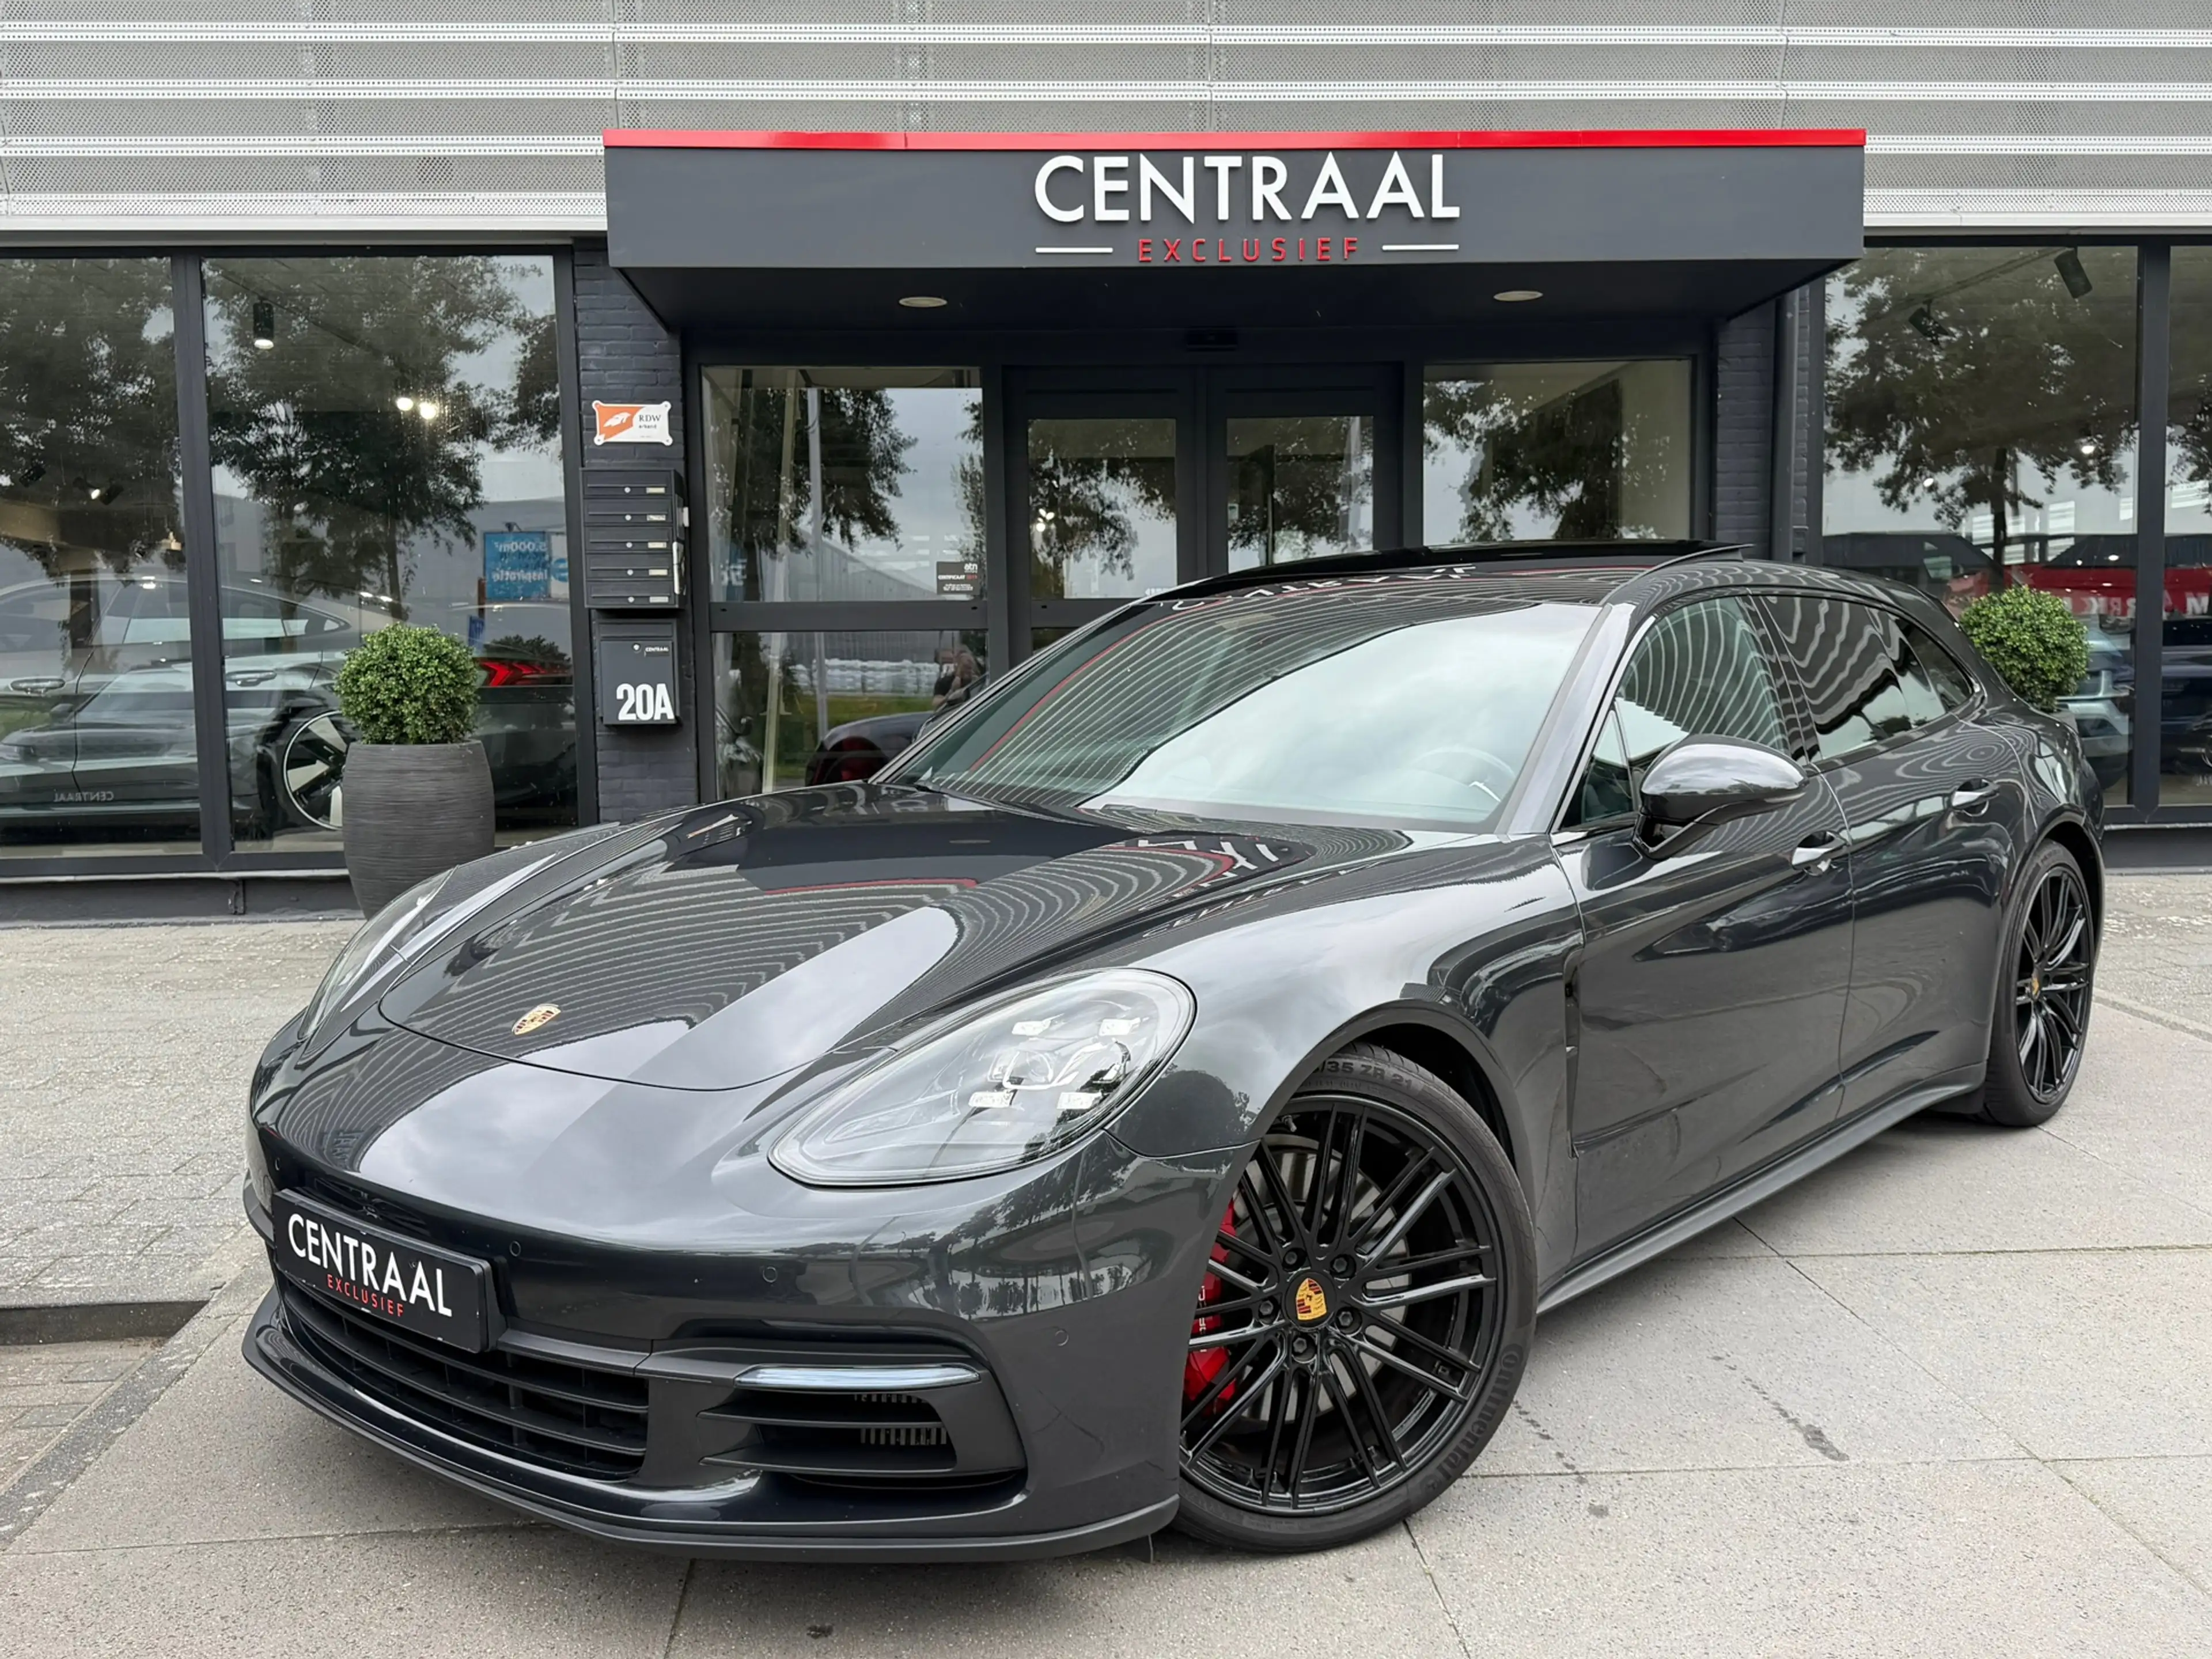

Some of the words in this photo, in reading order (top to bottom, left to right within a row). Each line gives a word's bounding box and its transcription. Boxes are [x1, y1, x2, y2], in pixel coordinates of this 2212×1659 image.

[1034, 151, 1461, 224] CENTRAAL
[1138, 237, 1359, 262] EXCLUSIEF
[616, 683, 675, 721] 20A
[1361, 1064, 1387, 1081] ZR
[1391, 1073, 1414, 1090] 21
[287, 1213, 453, 1318] CENTRAAL
[327, 1274, 404, 1317] EXCLUSIEF
[1438, 1343, 1524, 1480] Continental
